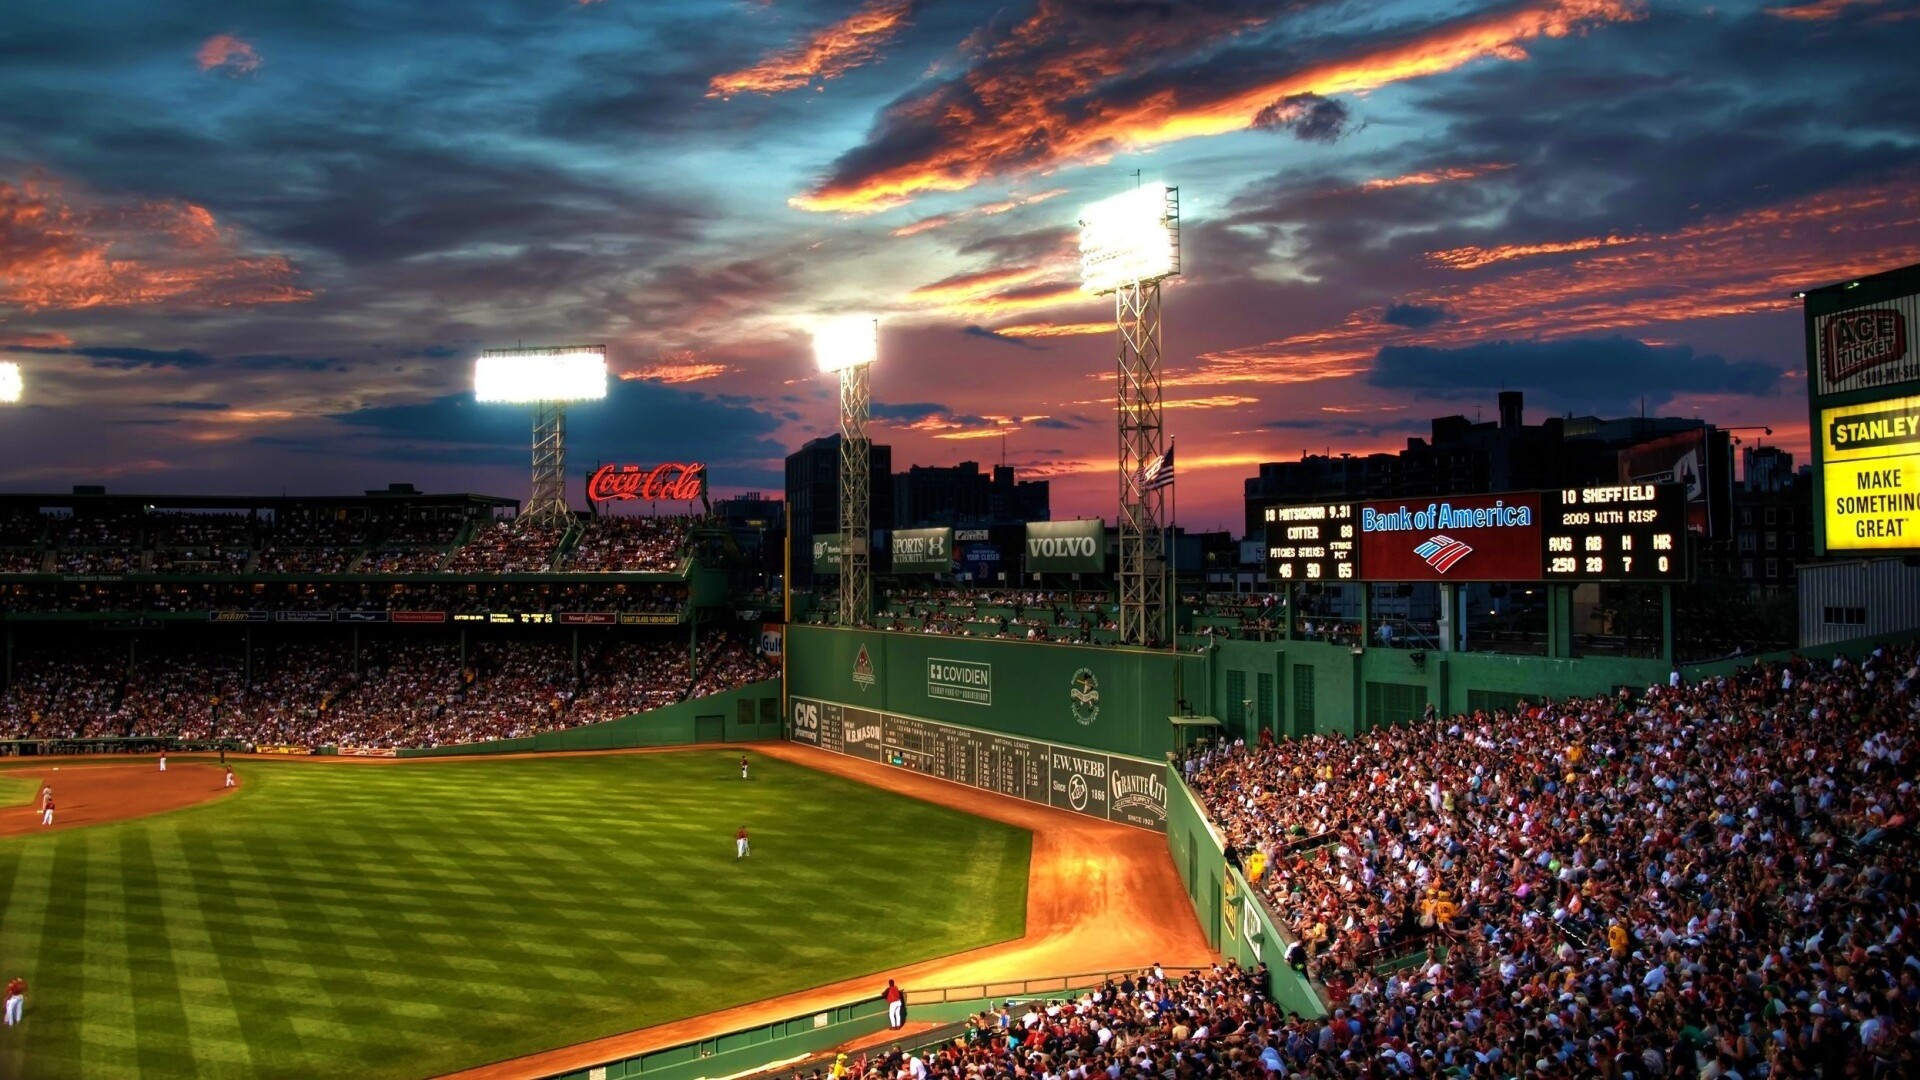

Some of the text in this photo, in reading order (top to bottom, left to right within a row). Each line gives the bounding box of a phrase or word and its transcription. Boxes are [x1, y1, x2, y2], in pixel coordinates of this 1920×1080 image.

[1837, 316, 1895, 350] ACE
[1839, 341, 1893, 371] TICKET
[1837, 415, 1920, 443] STANLEY
[588, 462, 704, 501] Coca-Cola
[1857, 469, 1902, 490] MAKE
[1562, 485, 1656, 504] 10 SHEFFIELD
[1279, 506, 1326, 521] MATSUZAKA
[1329, 505, 1351, 519] 9.31
[1362, 500, 1530, 532] Bank of America
[1562, 509, 1658, 525] 2009 WITH RISP
[1287, 526, 1320, 539] CUTTER
[892, 537, 924, 554] SPORTS
[1027, 536, 1097, 557] VOLVO
[1329, 541, 1352, 550] STRIKE
[1549, 534, 1672, 551] AVG AB H HR
[1270, 547, 1296, 558] PITCHES
[1298, 547, 1325, 558] STRIKES
[1334, 551, 1348, 559] PCT
[1279, 562, 1353, 578] 46 30 65
[1547, 556, 1669, 572] .250 28 7 0
[943, 666, 988, 685] COVIDIEN
[794, 702, 818, 730] CVS
[794, 727, 818, 743] pharmacy
[1053, 754, 1106, 779] F.W. WEBB
[1053, 780, 1106, 802] Since 1866
[1112, 769, 1149, 800] GRANITE
[1132, 795, 1151, 805] SUPPLY
[1127, 814, 1155, 826] SINCE 1923
